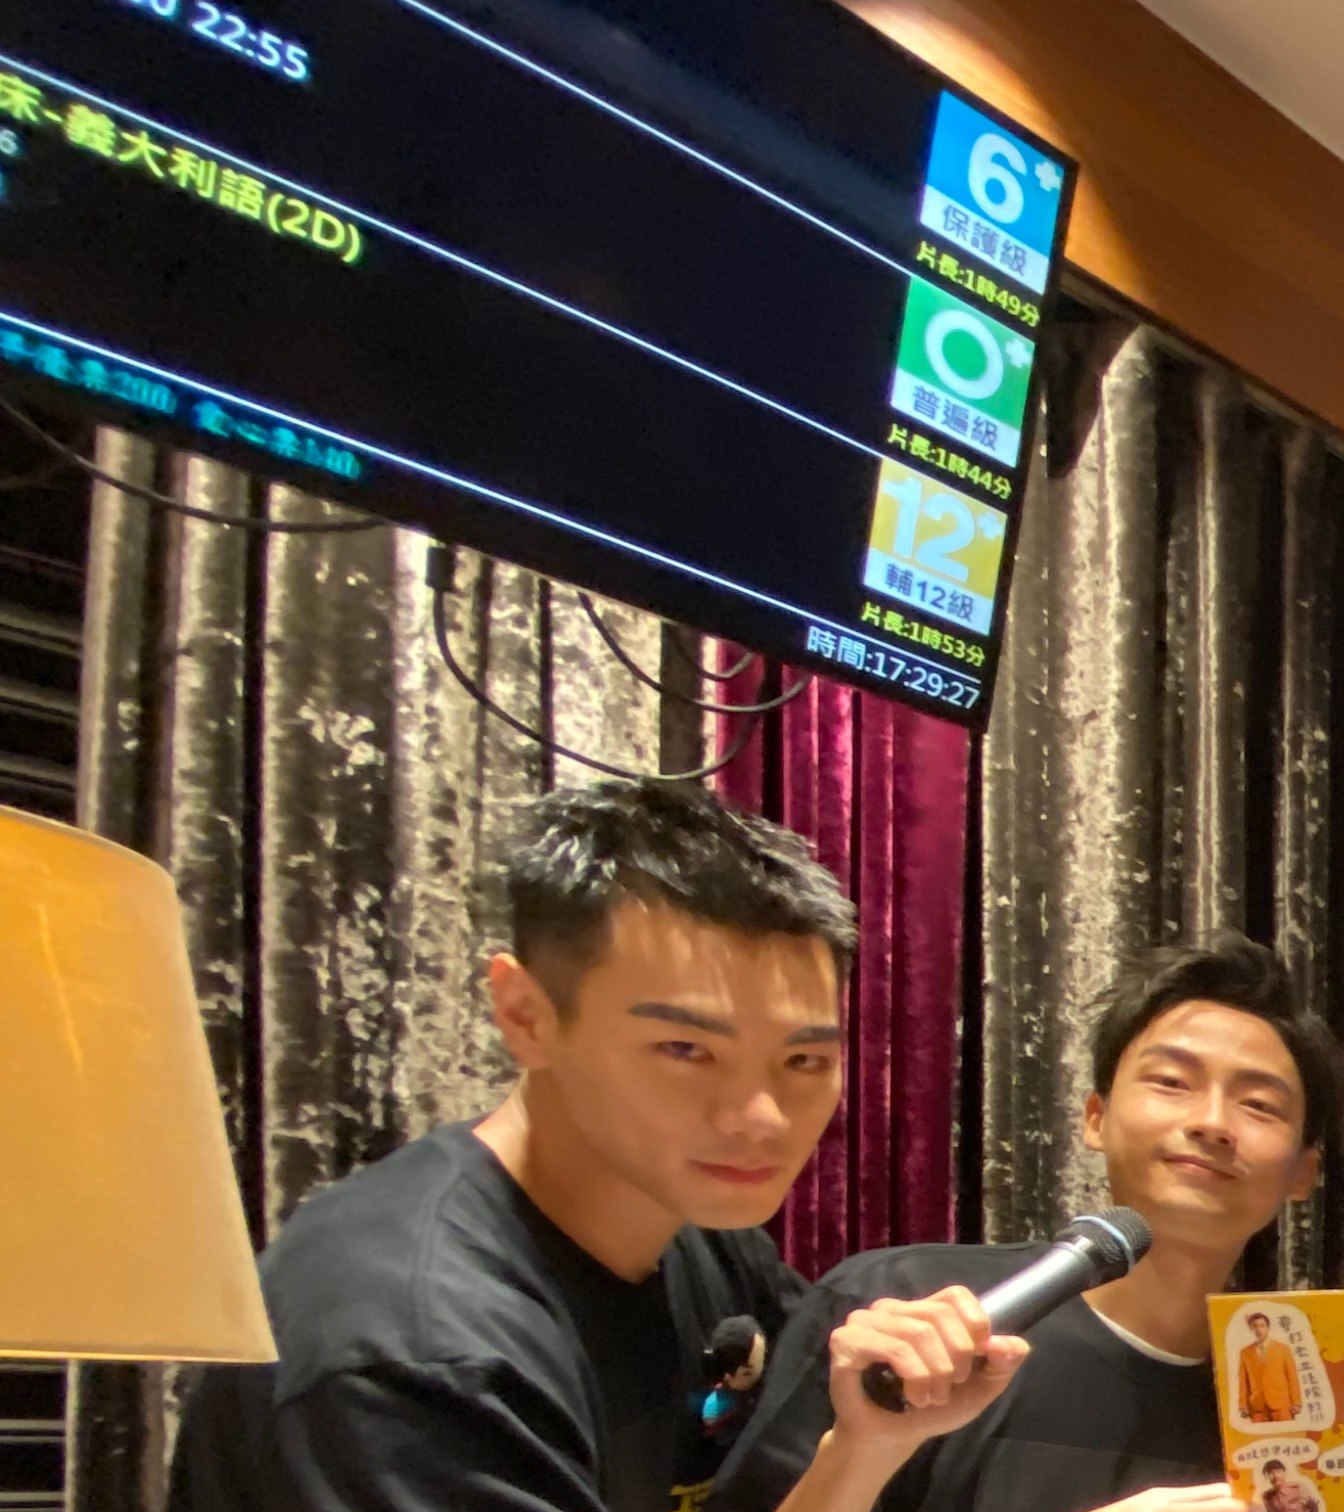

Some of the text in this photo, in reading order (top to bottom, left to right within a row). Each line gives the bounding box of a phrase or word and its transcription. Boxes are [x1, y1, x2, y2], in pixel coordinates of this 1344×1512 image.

[192, 1, 309, 80] 22:55
[942, 206, 1028, 277] 保護級
[916, 241, 1041, 328] 片長:1時49分
[911, 385, 999, 451] 普遍級
[887, 424, 1013, 500] 片長:1時44分
[885, 563, 974, 623] 輔12級
[807, 625, 980, 710] 時間:17:29:27
[861, 601, 986, 668] 片長:1時53分
